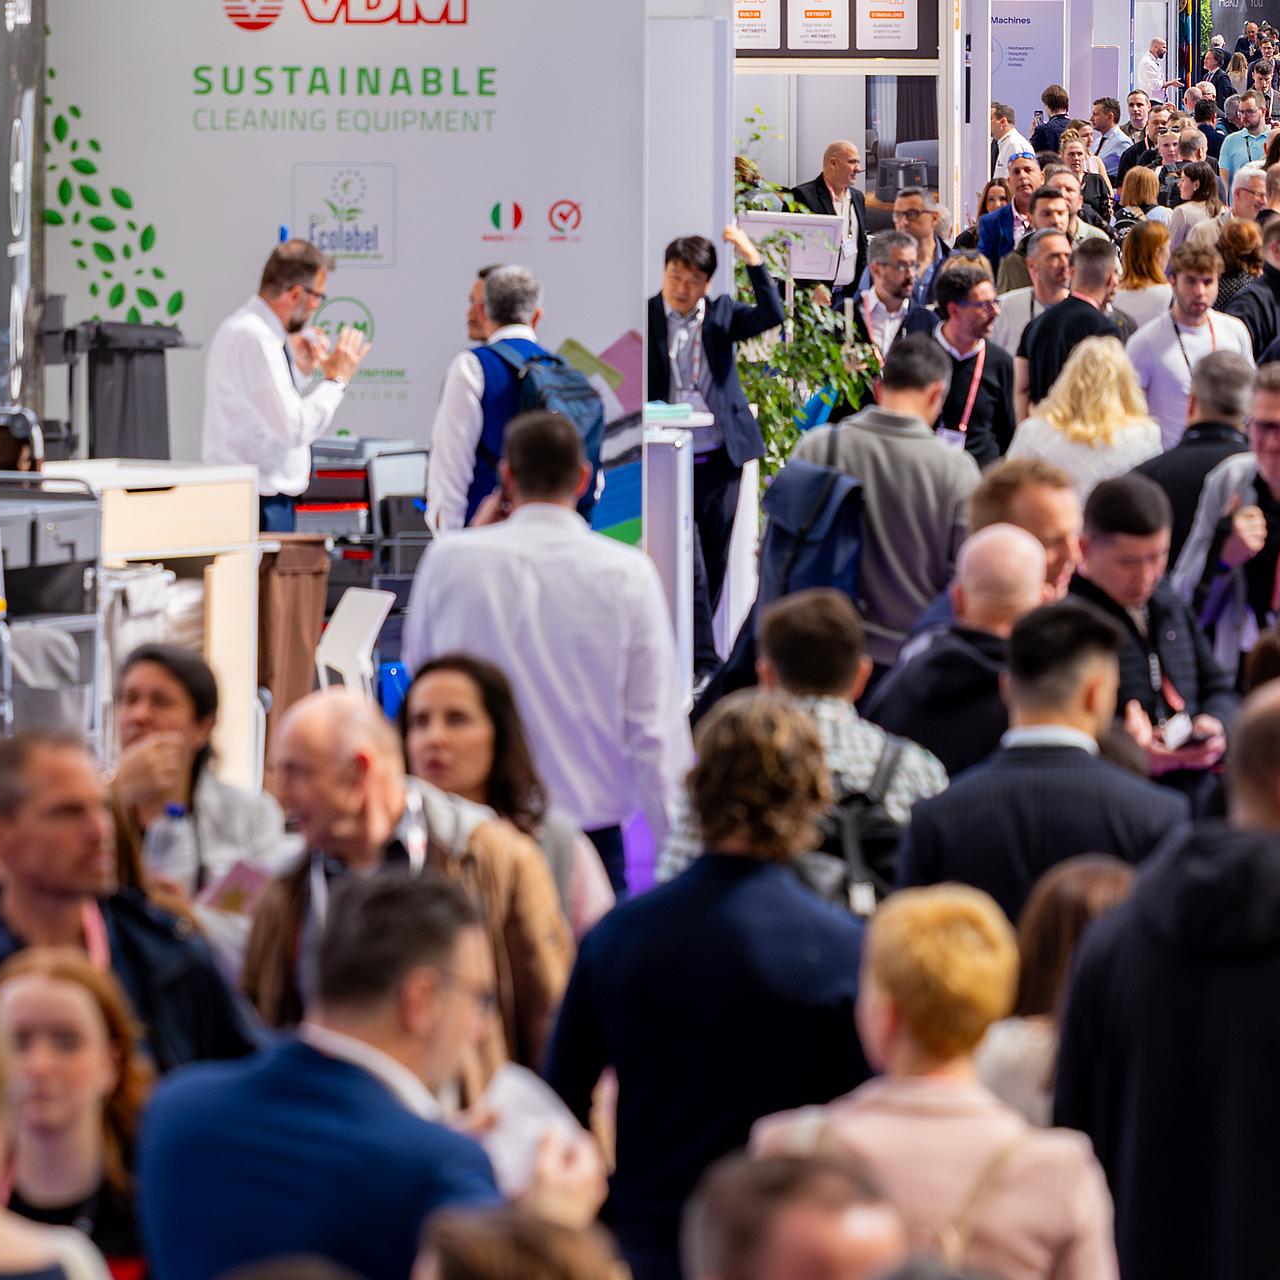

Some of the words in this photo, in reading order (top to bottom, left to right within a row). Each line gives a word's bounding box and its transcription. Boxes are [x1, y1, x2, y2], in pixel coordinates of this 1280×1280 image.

[991, 16, 1031, 24] Machines
[192, 66, 497, 96] SUSTAINABLE
[192, 107, 327, 132] CLEANING
[335, 108, 497, 134] EQUIPMENT
